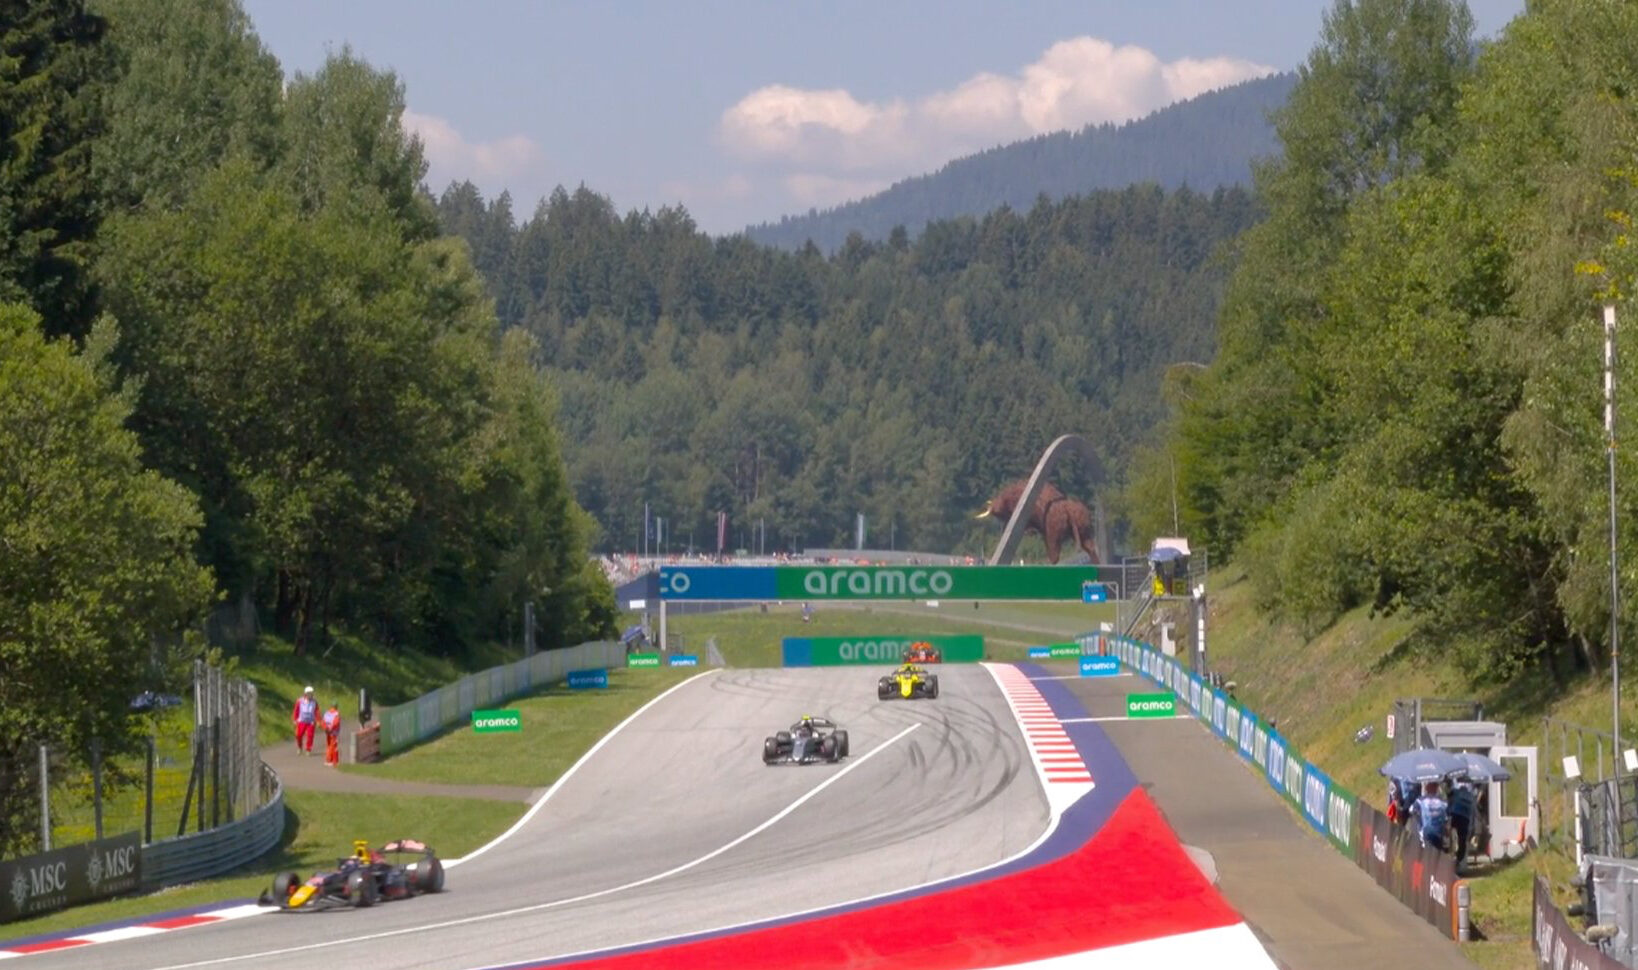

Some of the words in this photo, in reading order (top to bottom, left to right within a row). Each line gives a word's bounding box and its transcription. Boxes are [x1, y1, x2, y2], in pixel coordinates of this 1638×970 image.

[804, 570, 953, 594] aramco
[839, 640, 914, 661] aram
[1082, 661, 1116, 671] aramco
[1129, 700, 1173, 711] aramco
[475, 716, 518, 728] aramco
[104, 845, 135, 880] MSC
[30, 861, 66, 897] MSC
